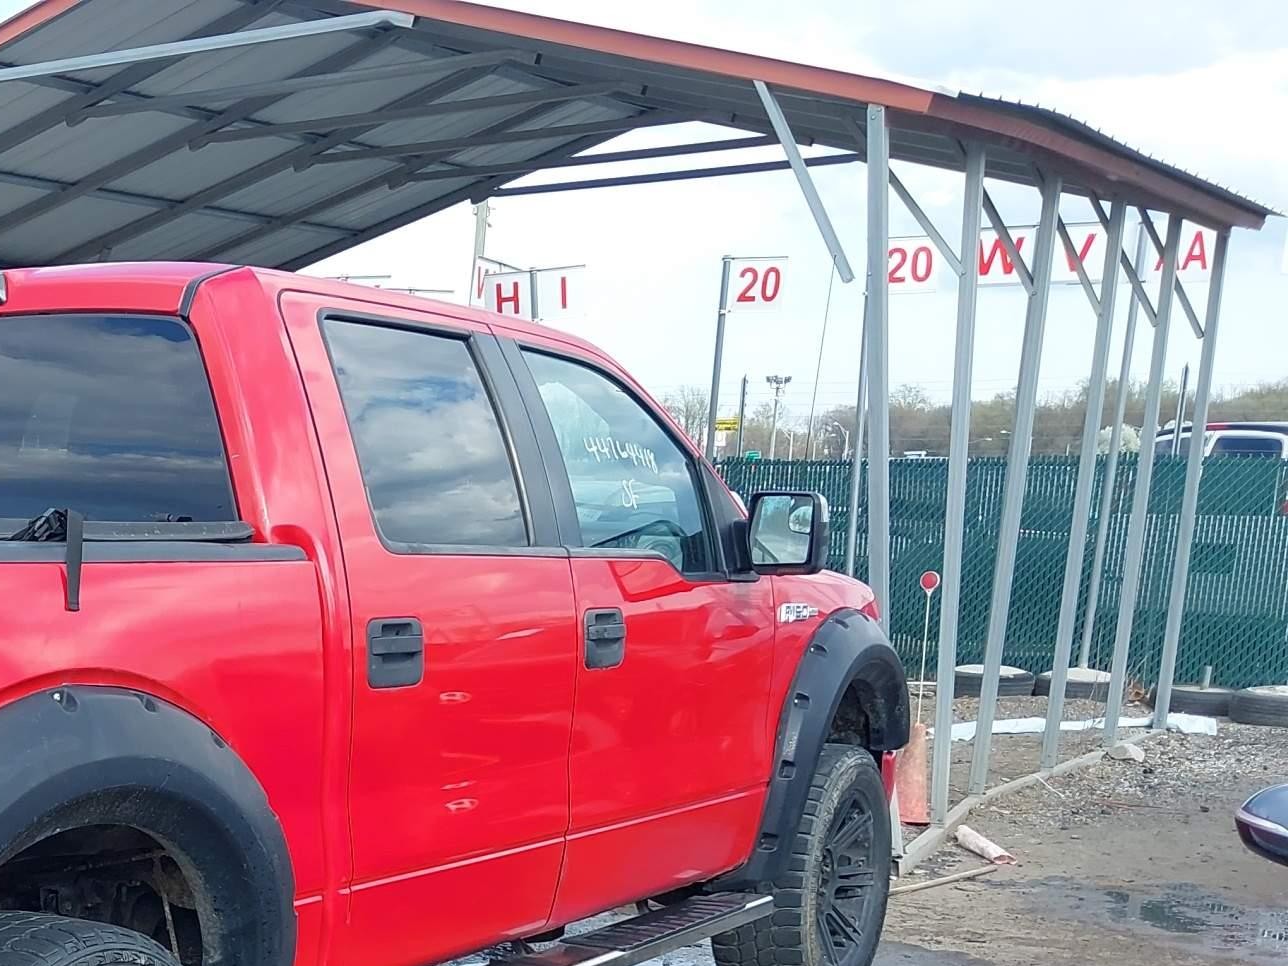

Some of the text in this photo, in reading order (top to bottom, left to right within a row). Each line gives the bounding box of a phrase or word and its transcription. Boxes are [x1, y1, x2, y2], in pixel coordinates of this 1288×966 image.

[888, 246, 933, 284] 20
[495, 281, 520, 315] H
[735, 266, 781, 303] 20
[583, 436, 659, 475] 44764418
